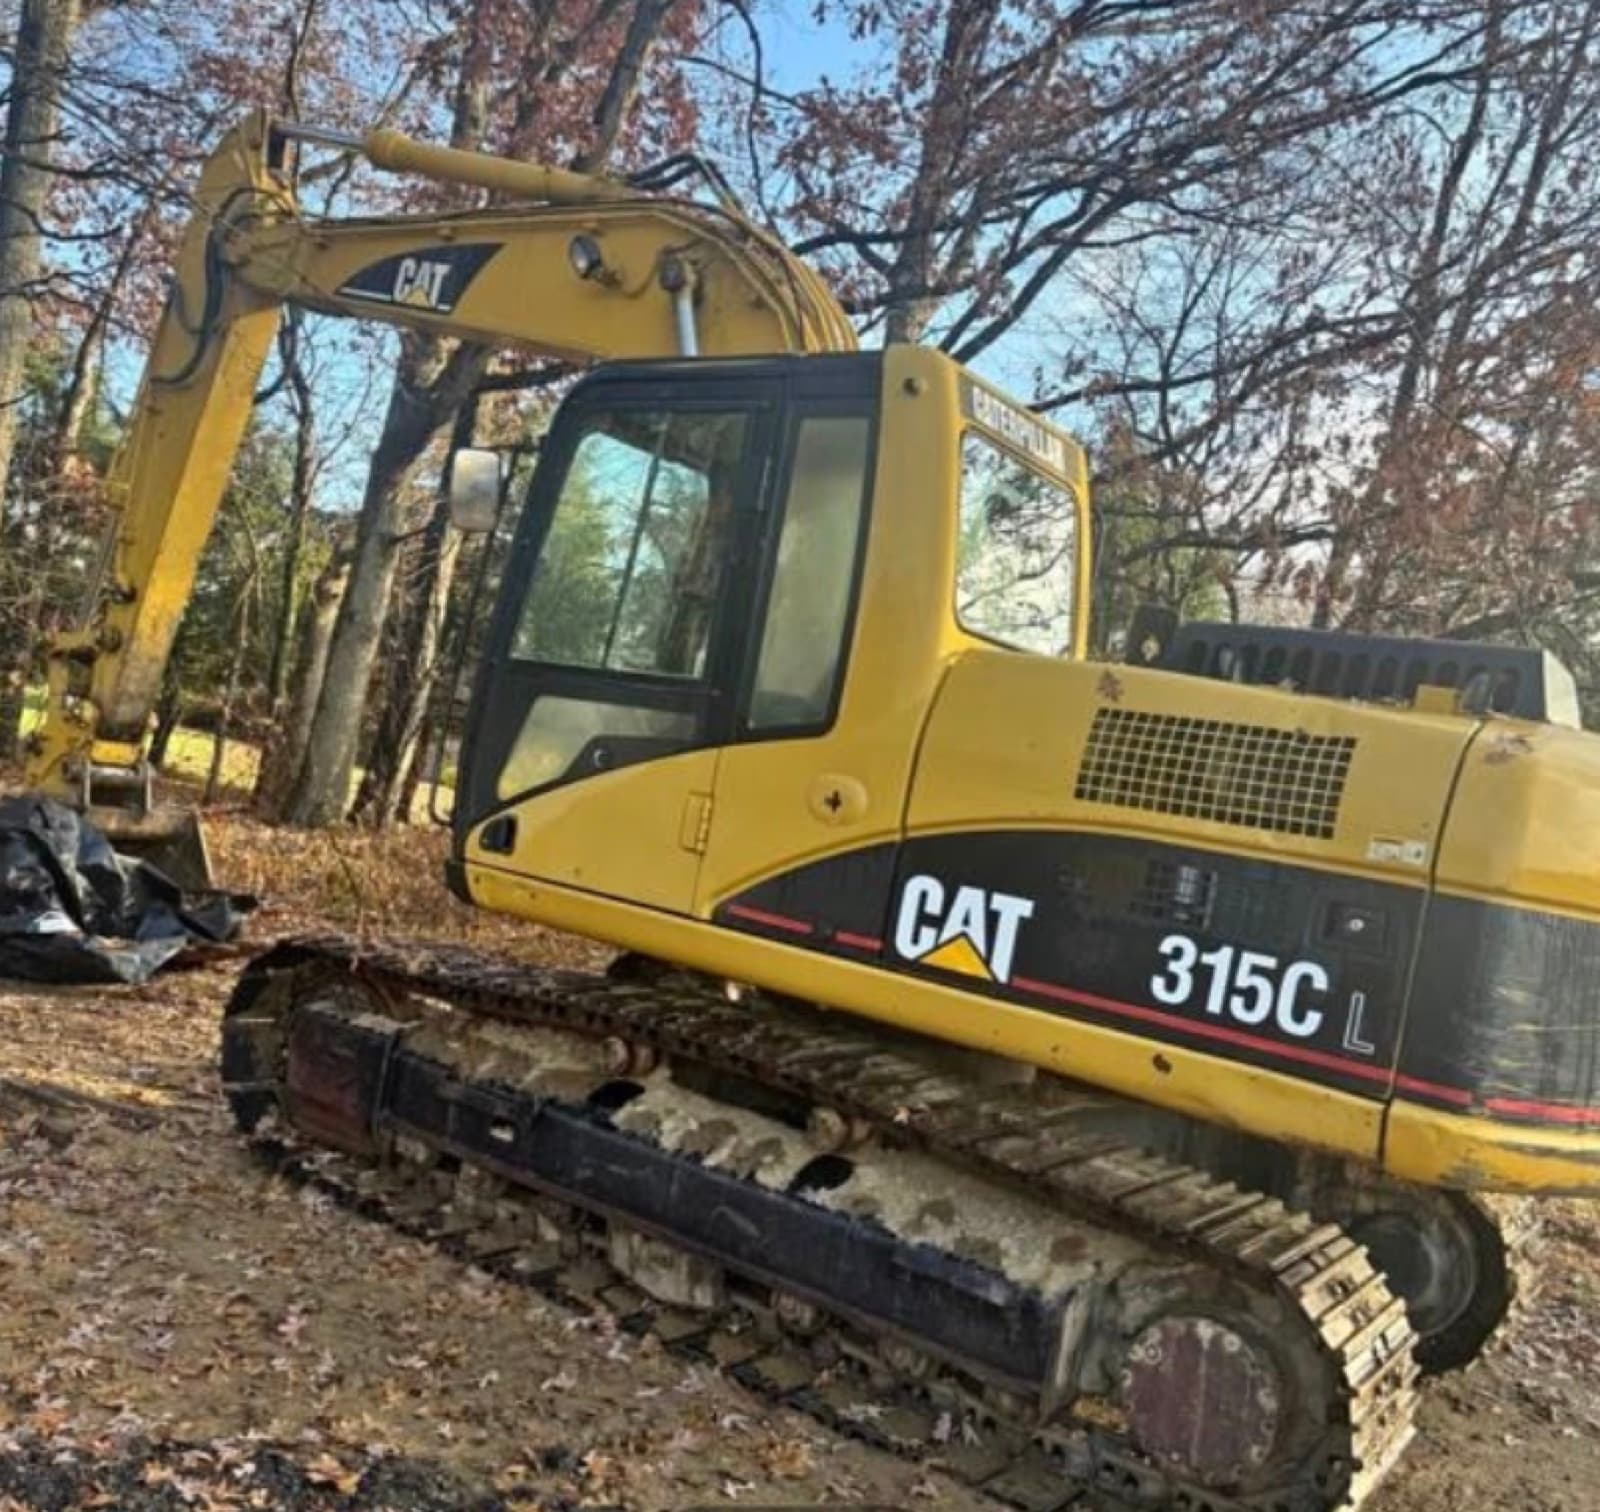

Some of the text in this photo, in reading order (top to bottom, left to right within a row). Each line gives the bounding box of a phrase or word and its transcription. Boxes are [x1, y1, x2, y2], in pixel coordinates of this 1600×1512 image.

[393, 258, 451, 306] CAT
[895, 875, 1034, 983] CAT
[1151, 935, 1374, 1053] 315C L
